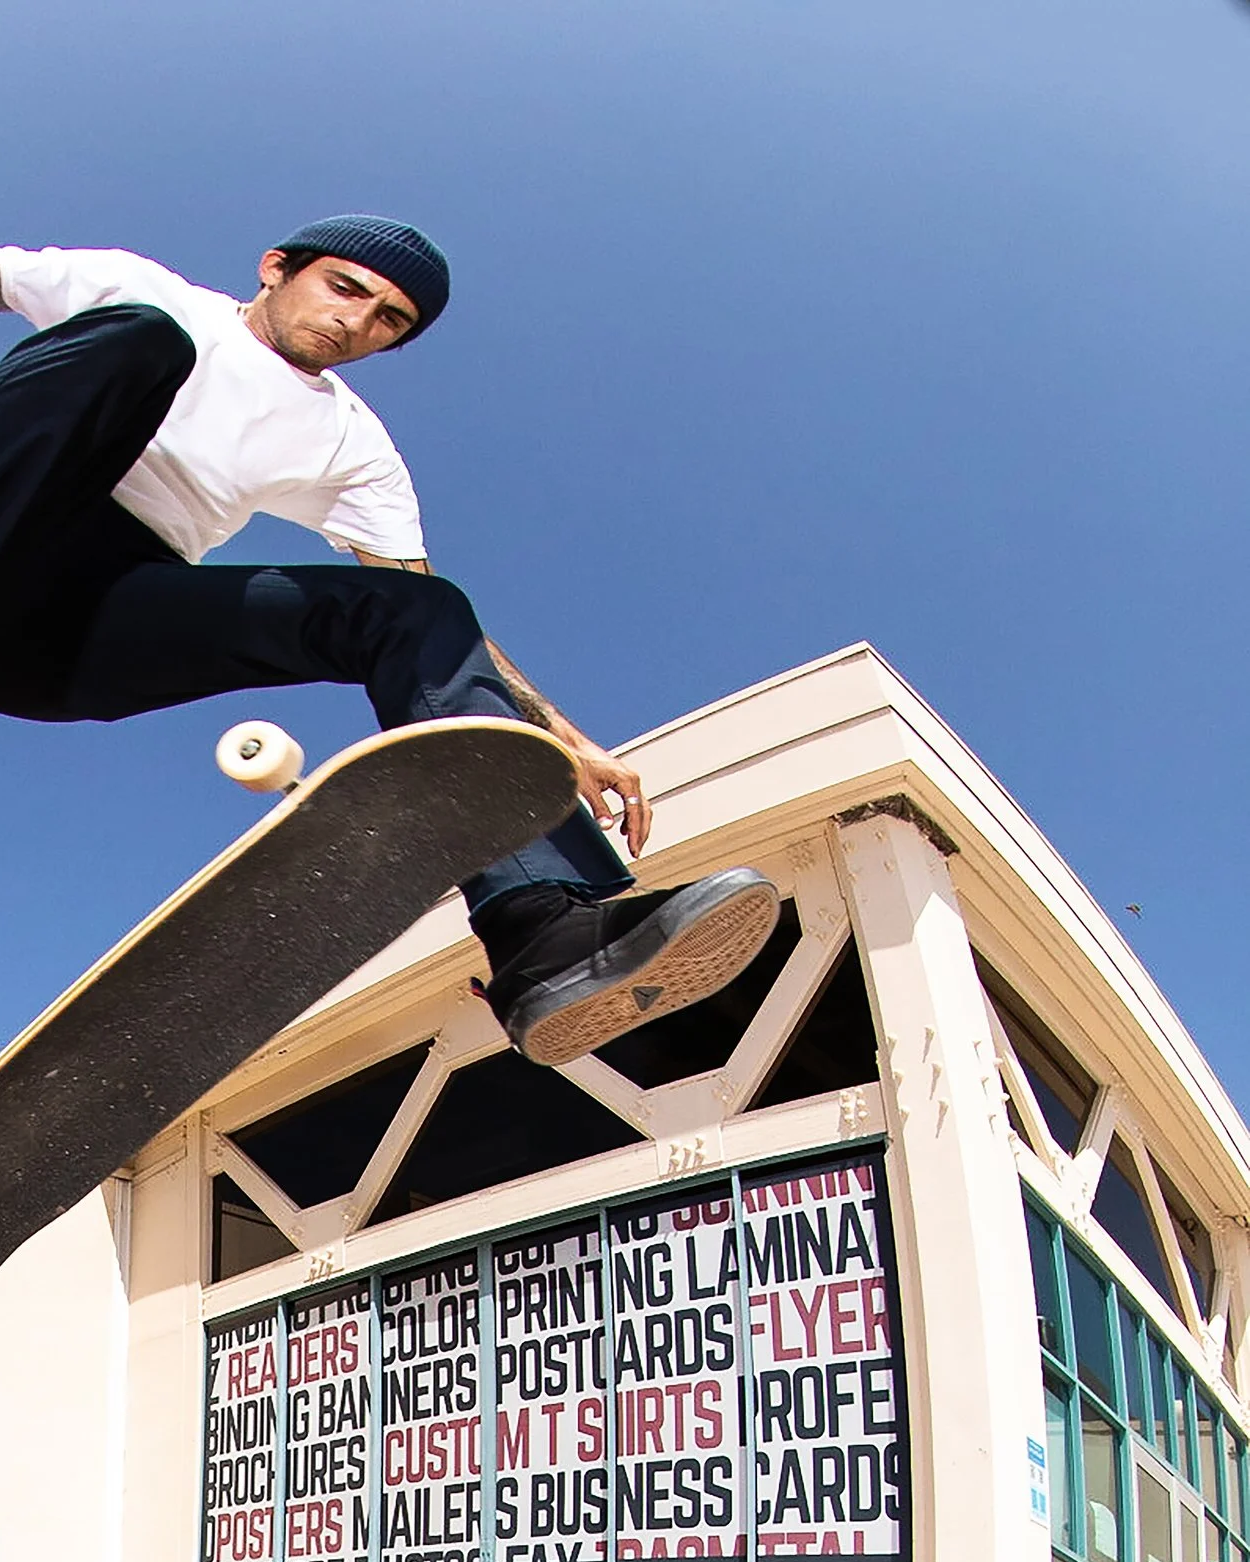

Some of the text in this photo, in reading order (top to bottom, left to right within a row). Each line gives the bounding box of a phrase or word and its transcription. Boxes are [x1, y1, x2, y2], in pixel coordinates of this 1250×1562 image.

[208, 1389, 310, 1457] BINDING
[319, 1353, 477, 1437] BANNERS
[496, 1303, 735, 1405] POSTCARDS
[228, 1320, 359, 1400] READERS
[369, 1289, 480, 1366] COLOR
[499, 1241, 674, 1339] PRINTNG
[206, 1435, 366, 1509] BROCHURES
[385, 1407, 530, 1487] CUSTOM
[541, 1402, 565, 1466] T
[577, 1379, 723, 1462] SHIRTS
[216, 1498, 343, 1562] POSTERS
[352, 1477, 519, 1551] MAILERS
[530, 1456, 733, 1538] BUSNESS
[756, 1441, 900, 1525] CARDS
